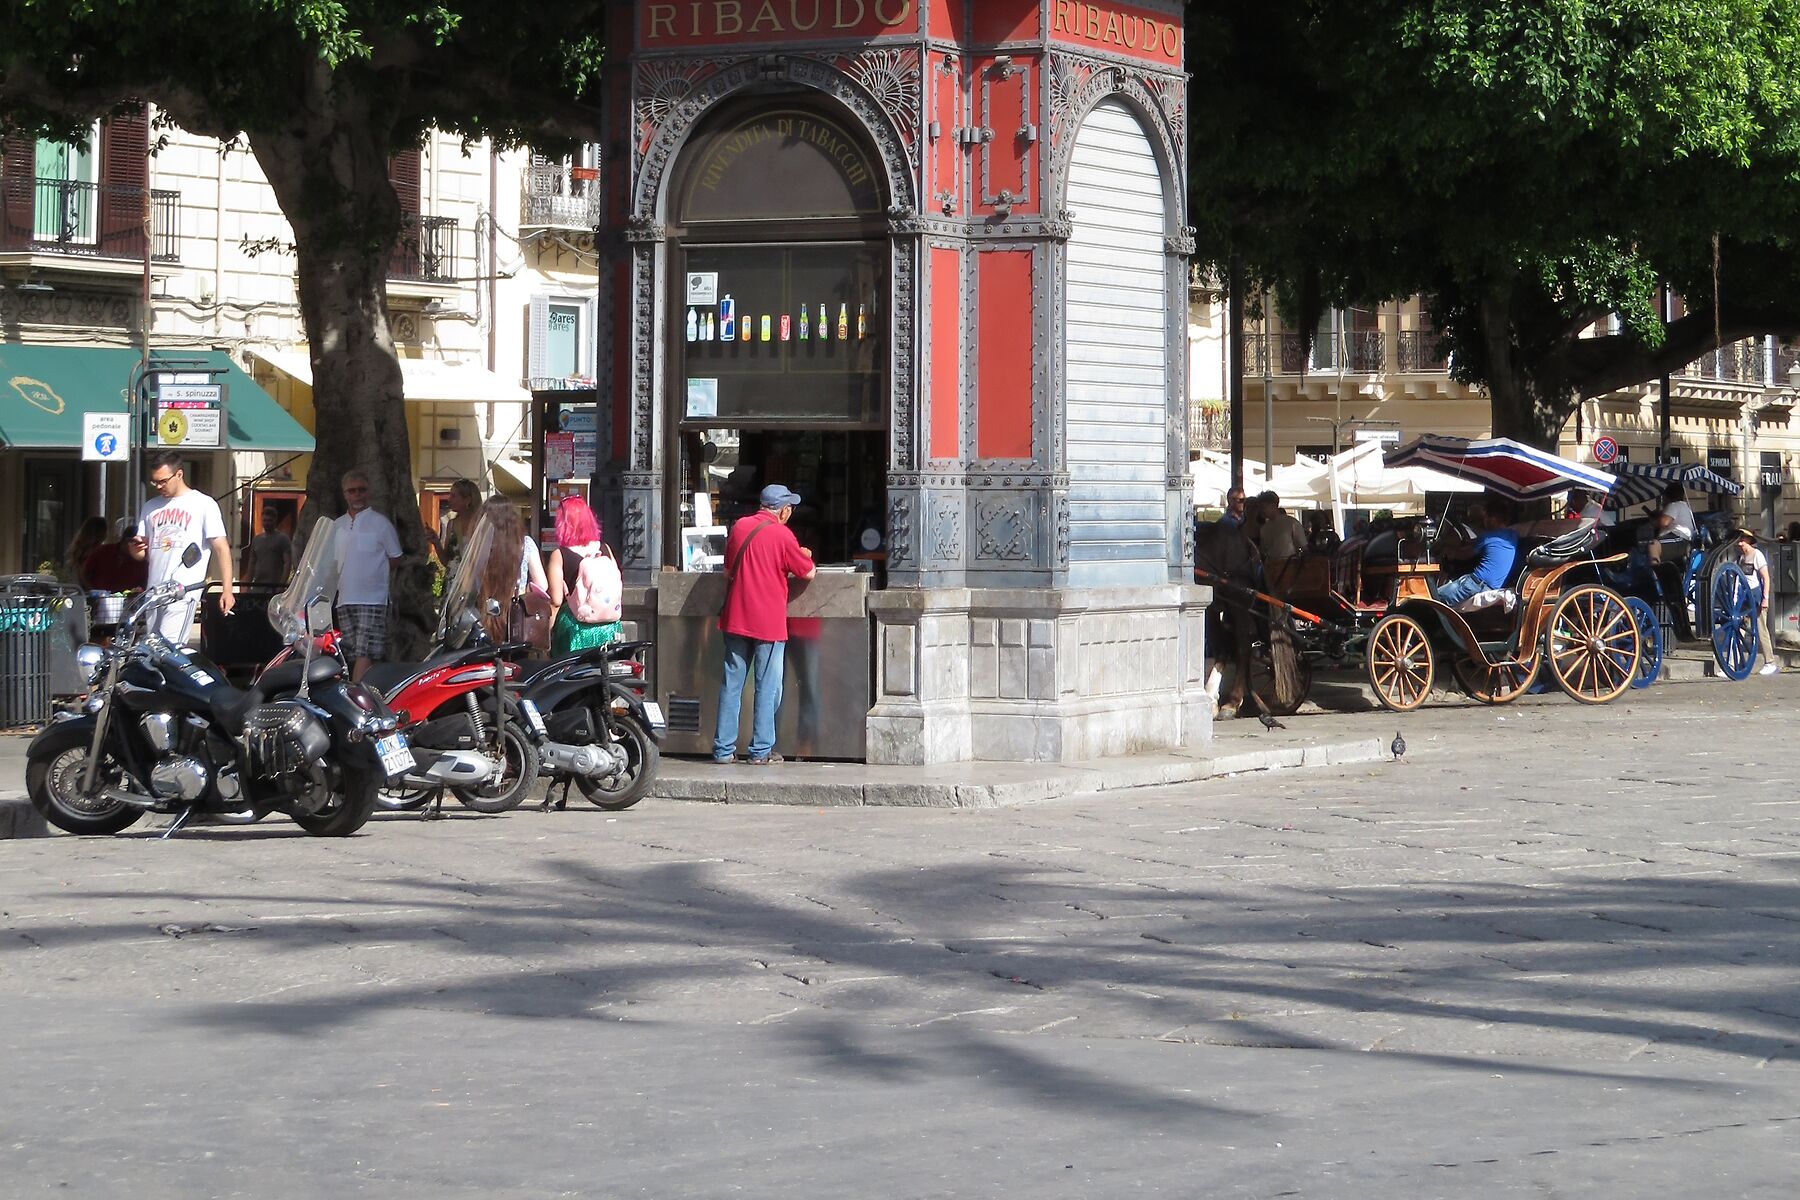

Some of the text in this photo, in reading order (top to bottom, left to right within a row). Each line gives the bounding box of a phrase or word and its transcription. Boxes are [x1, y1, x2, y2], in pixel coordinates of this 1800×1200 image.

[702, 119, 868, 192] RIVENDITA DI TABACCHI
[185, 389, 218, 398] spinuzza
[1710, 457, 1731, 467] SEPHORA
[152, 508, 193, 533] TOMMY
